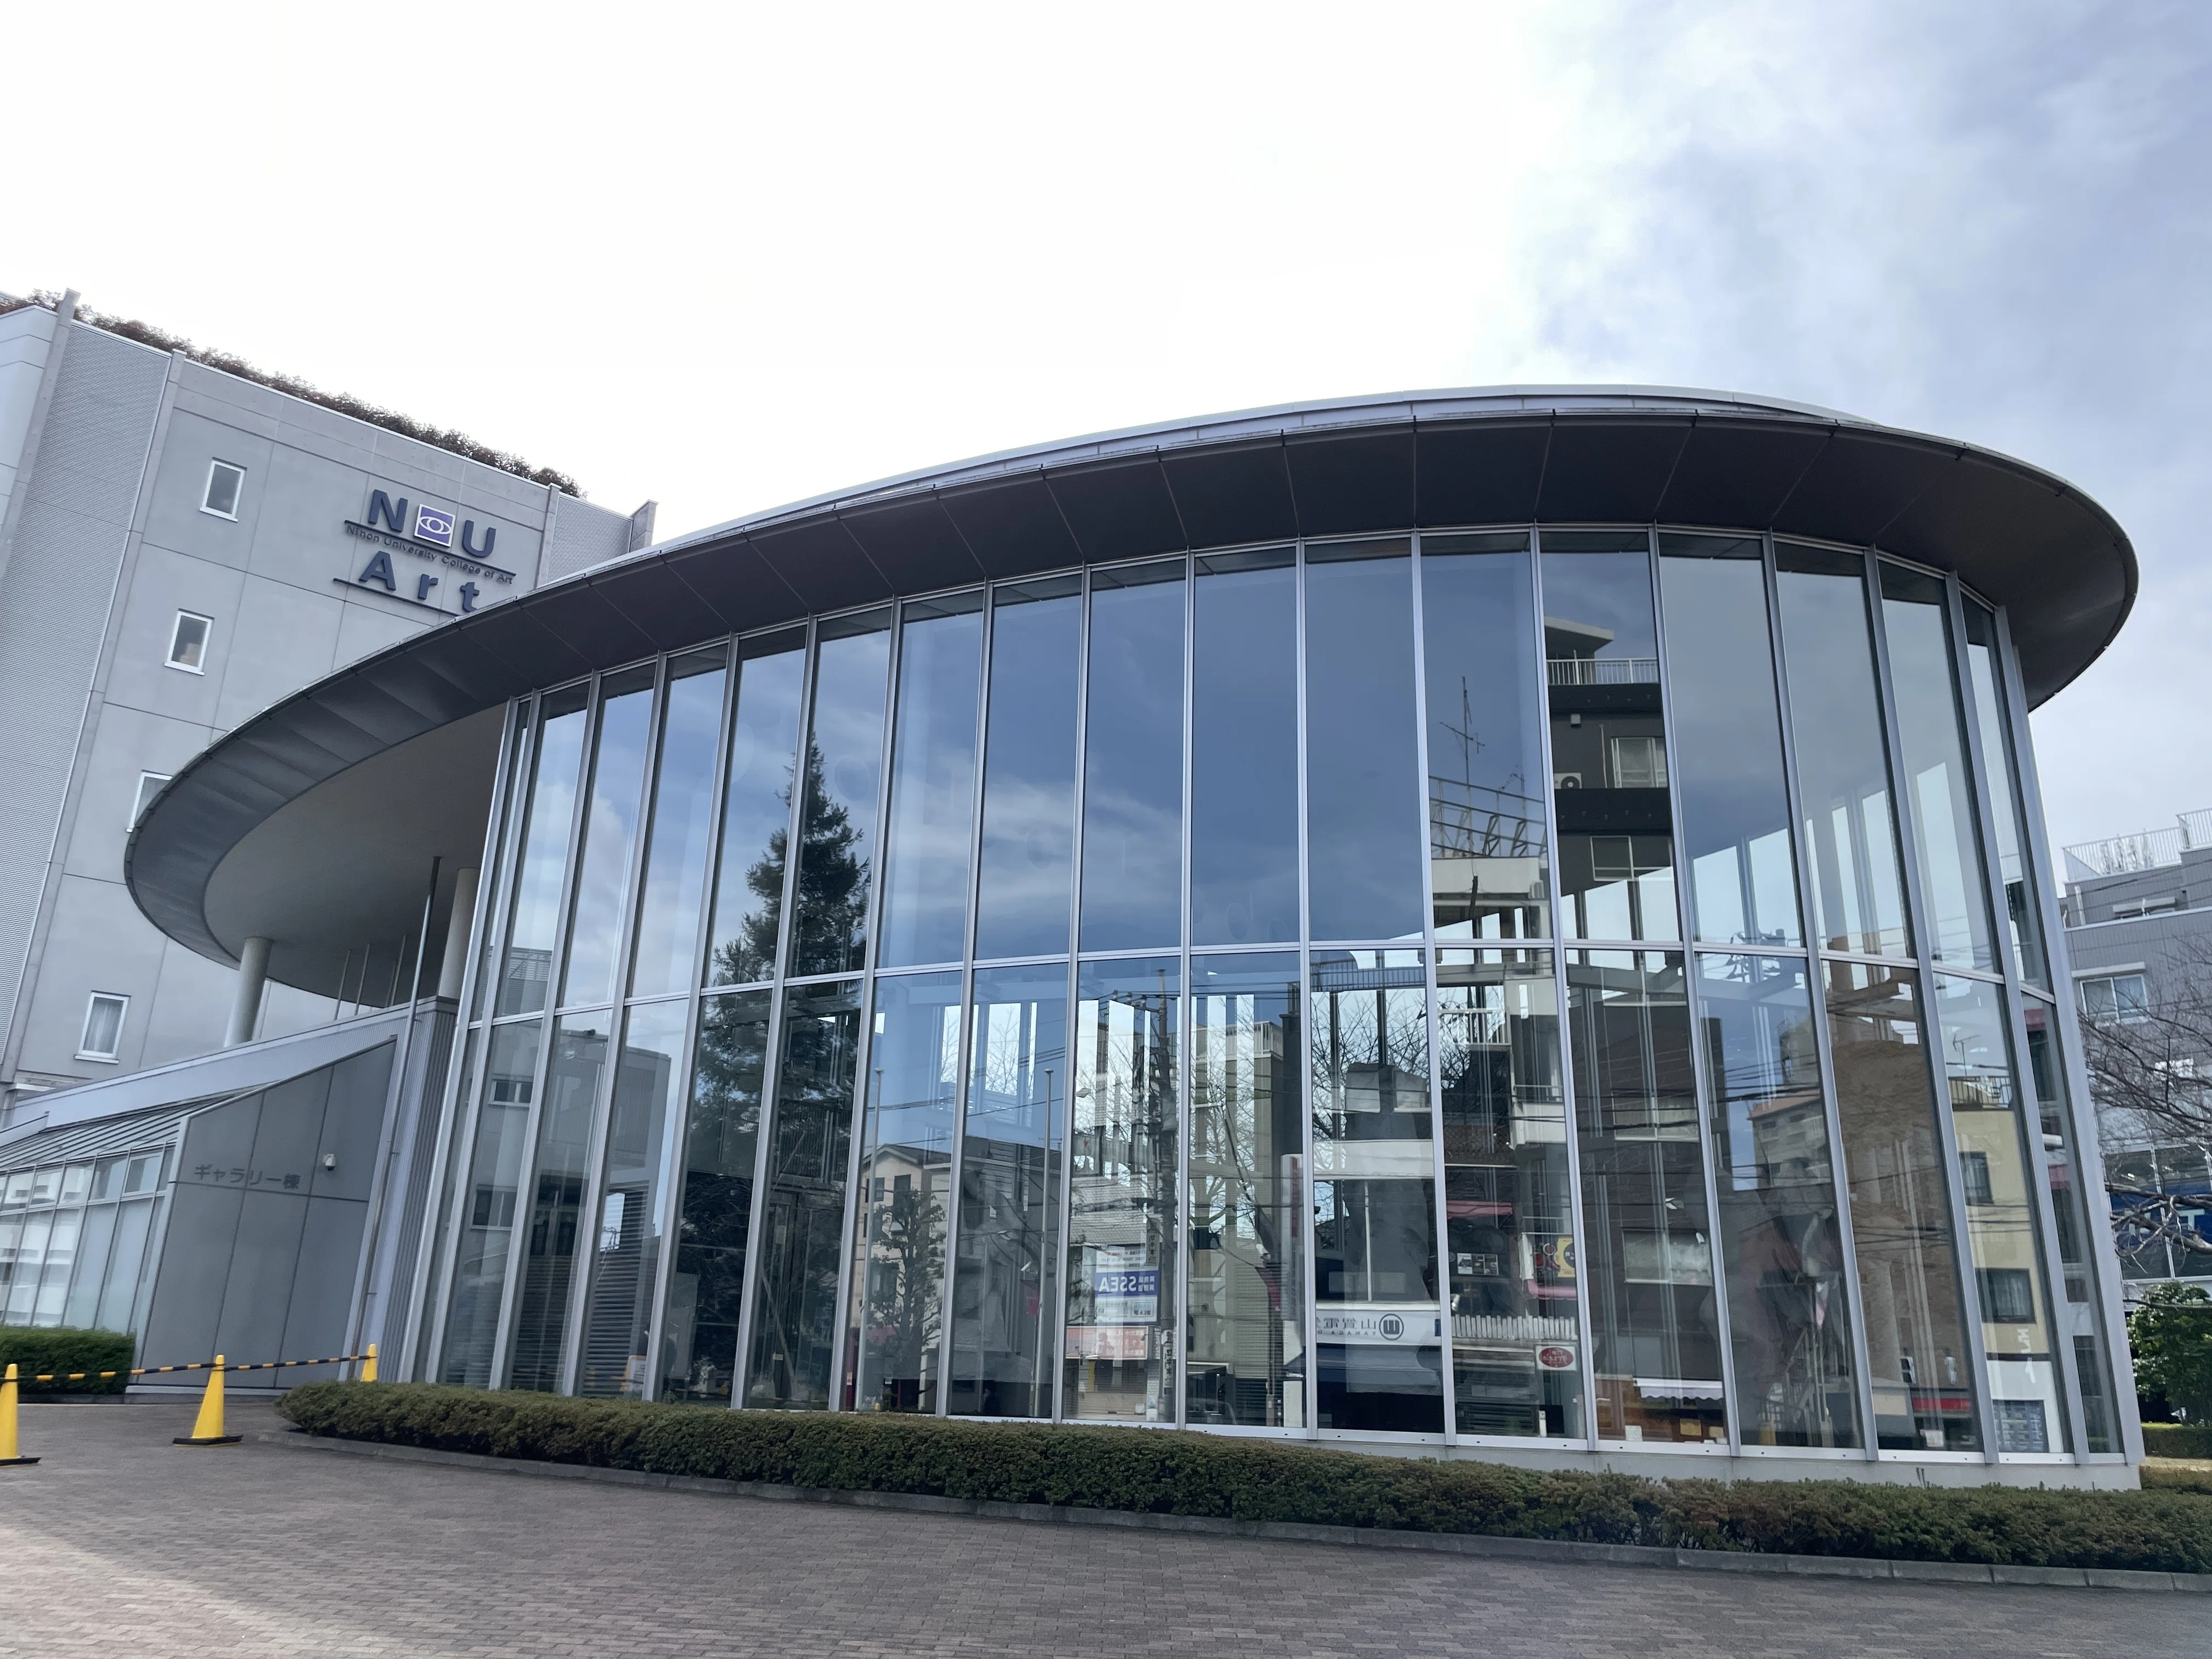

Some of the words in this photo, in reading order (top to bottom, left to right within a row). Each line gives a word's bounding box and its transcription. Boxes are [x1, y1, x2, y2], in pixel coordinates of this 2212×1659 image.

[346, 524, 380, 543] Nihon
[384, 537, 437, 562] University
[441, 555, 481, 575] College
[484, 569, 495, 579] of
[498, 573, 514, 584] Art
[359, 550, 480, 612] Art
[194, 1163, 301, 1189] ギャラリー棟
